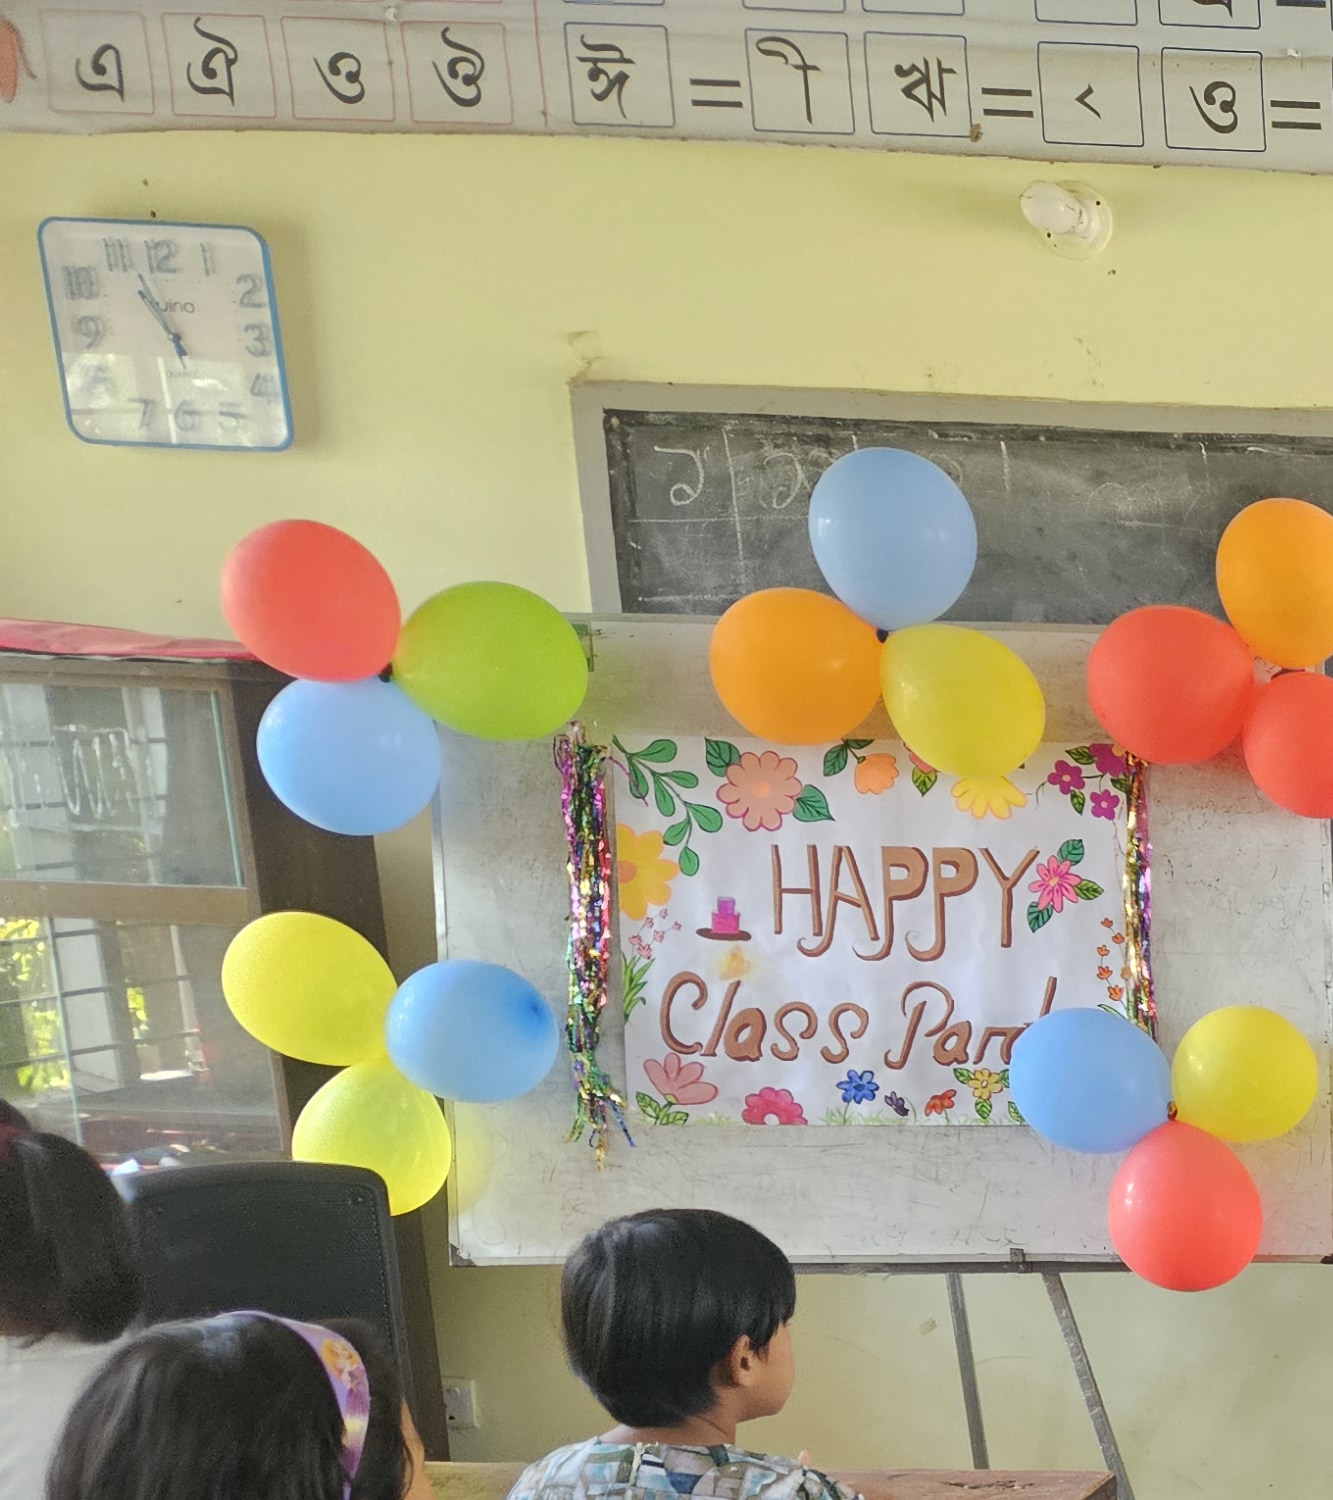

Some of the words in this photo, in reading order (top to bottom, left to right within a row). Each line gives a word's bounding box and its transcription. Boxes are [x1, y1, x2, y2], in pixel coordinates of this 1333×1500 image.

[76, 44, 124, 101] এ
[187, 17, 238, 106] ঐ
[314, 52, 365, 104] ও
[433, 27, 484, 107] ঔ
[576, 34, 636, 119] ঈ
[895, 58, 957, 122] ঋ
[1189, 81, 1237, 133] ও
[144, 239, 179, 274] 12
[236, 273, 264, 308] 2
[77, 315, 104, 350] 9
[243, 323, 271, 357] 3
[770, 844, 1041, 963] HAPPY
[660, 969, 869, 1065] Class
[884, 975, 1058, 1071] Par
